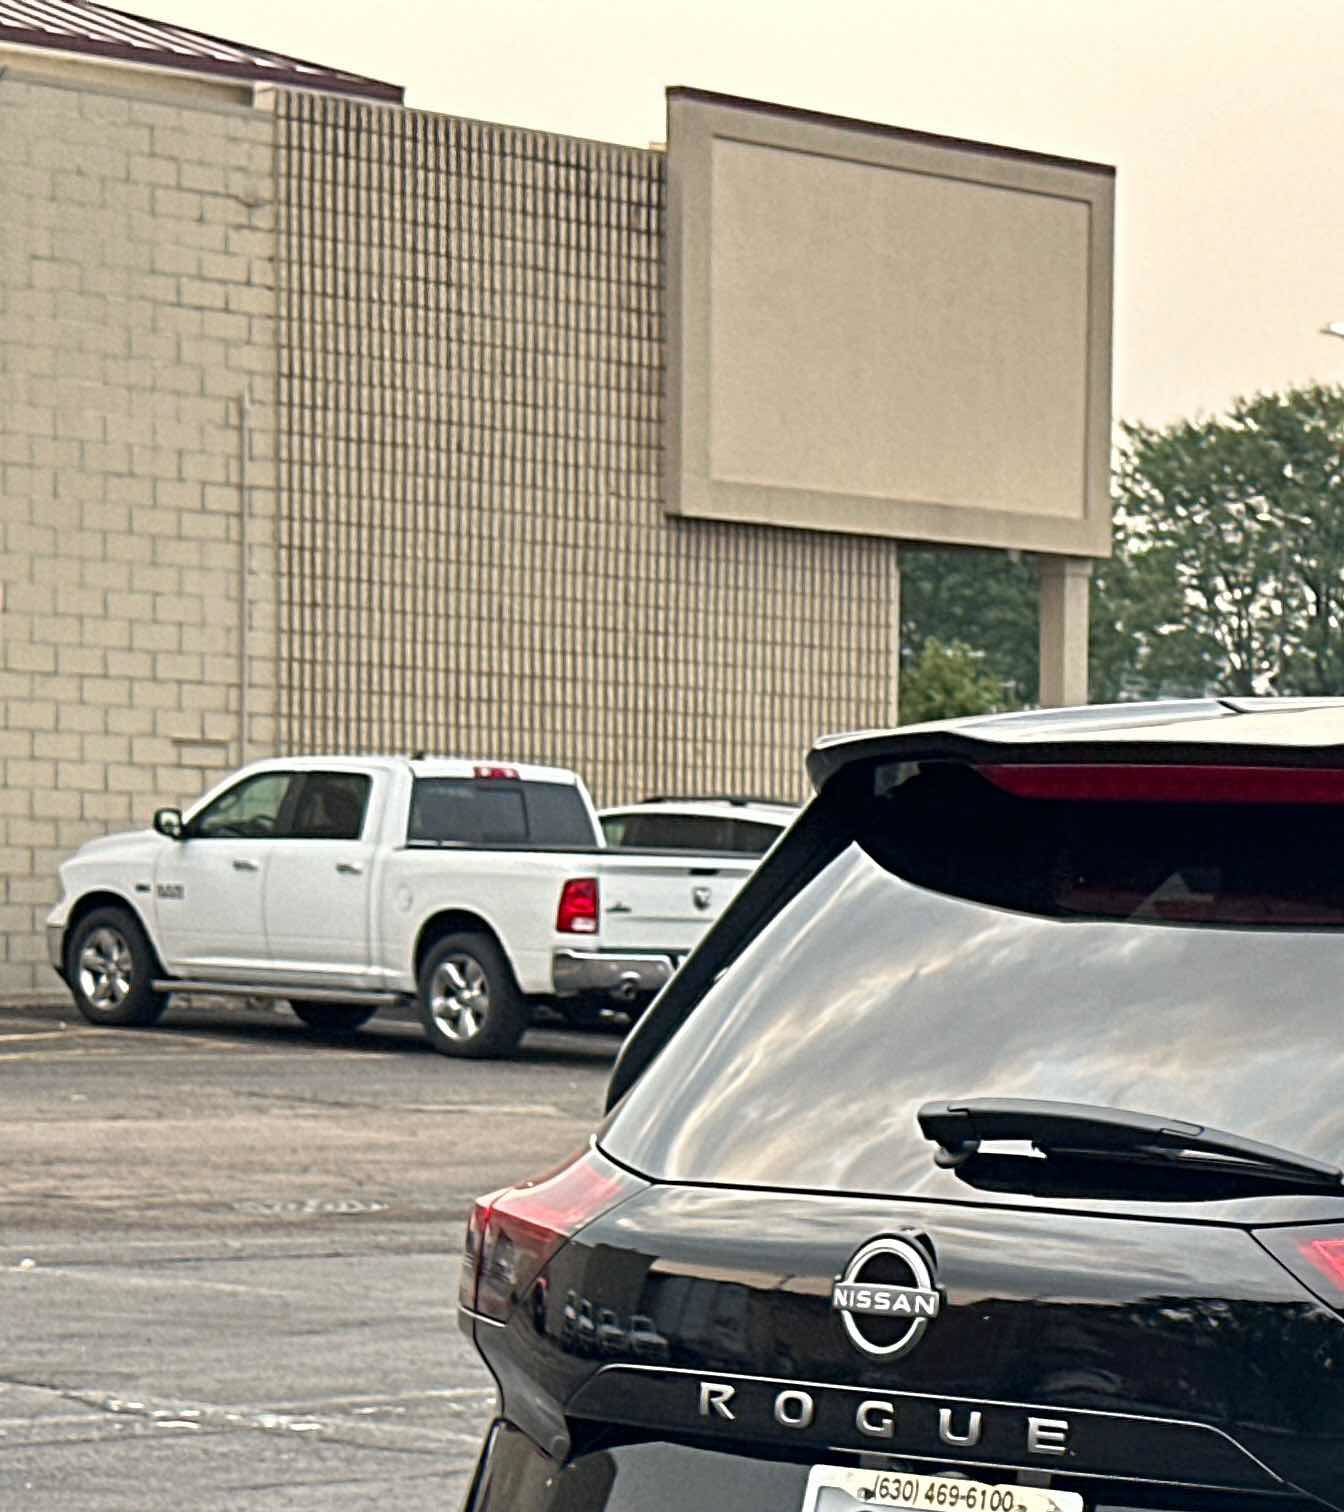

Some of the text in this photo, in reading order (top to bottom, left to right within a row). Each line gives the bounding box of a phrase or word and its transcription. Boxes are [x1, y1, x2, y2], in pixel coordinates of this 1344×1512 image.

[833, 1287, 935, 1316] NISSAN
[699, 1382, 1071, 1457] ROGUE
[873, 1475, 1014, 1512] (630) 469-6100
